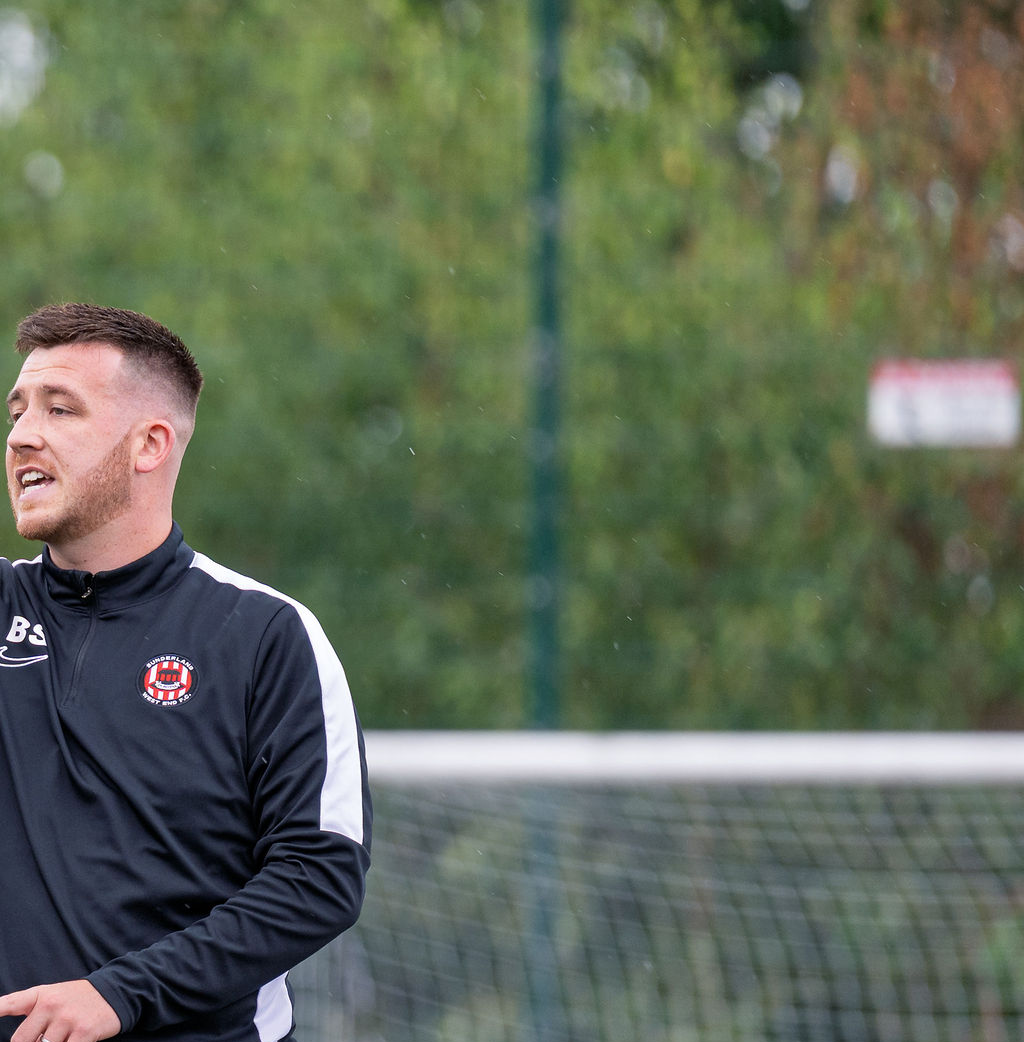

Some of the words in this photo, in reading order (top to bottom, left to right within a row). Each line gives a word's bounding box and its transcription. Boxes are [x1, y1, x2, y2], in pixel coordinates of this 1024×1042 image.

[6, 616, 47, 646] BS
[146, 656, 194, 671] SUNDERLAND
[142, 692, 160, 705] WEST
